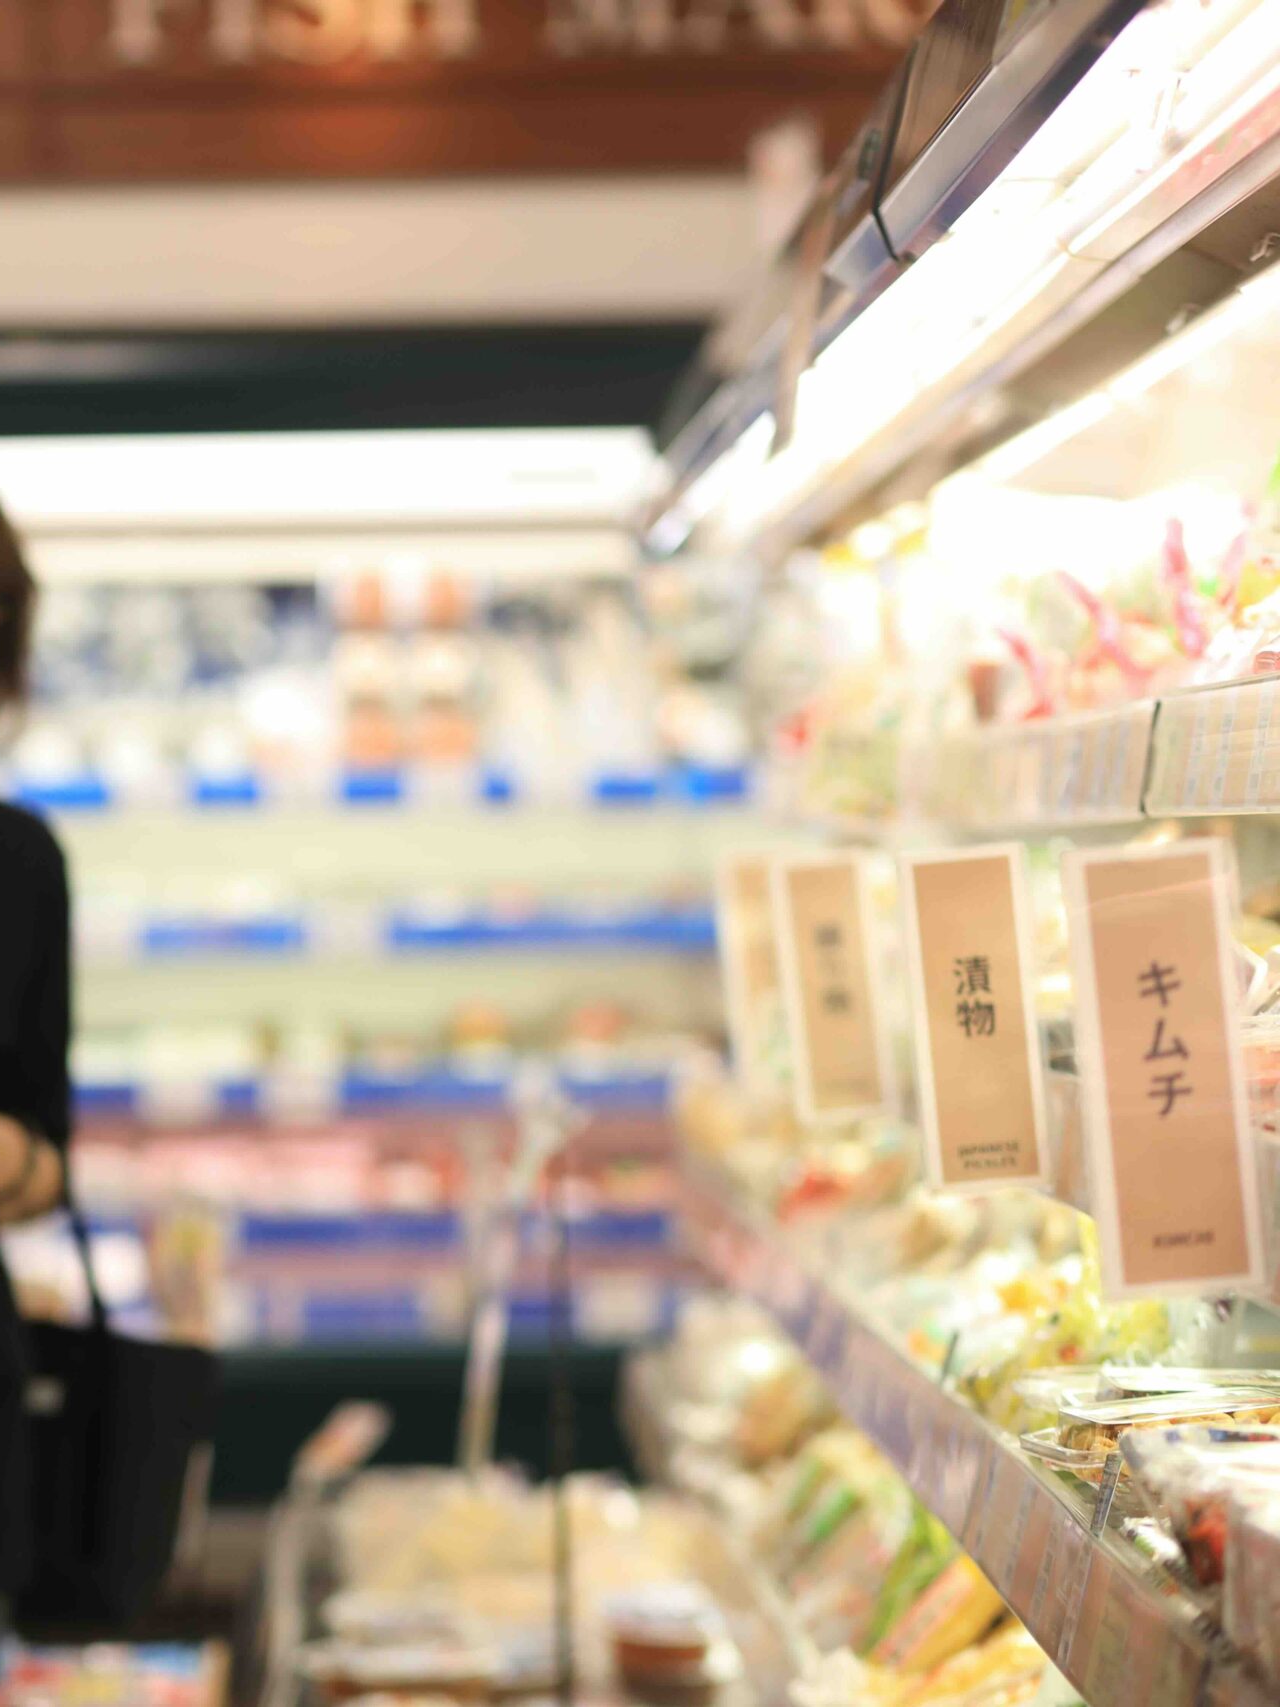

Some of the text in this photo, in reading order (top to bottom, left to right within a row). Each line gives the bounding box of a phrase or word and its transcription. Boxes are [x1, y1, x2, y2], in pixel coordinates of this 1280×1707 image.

[953, 956, 996, 1037] 漬物
[1138, 960, 1194, 1118] キムチ
